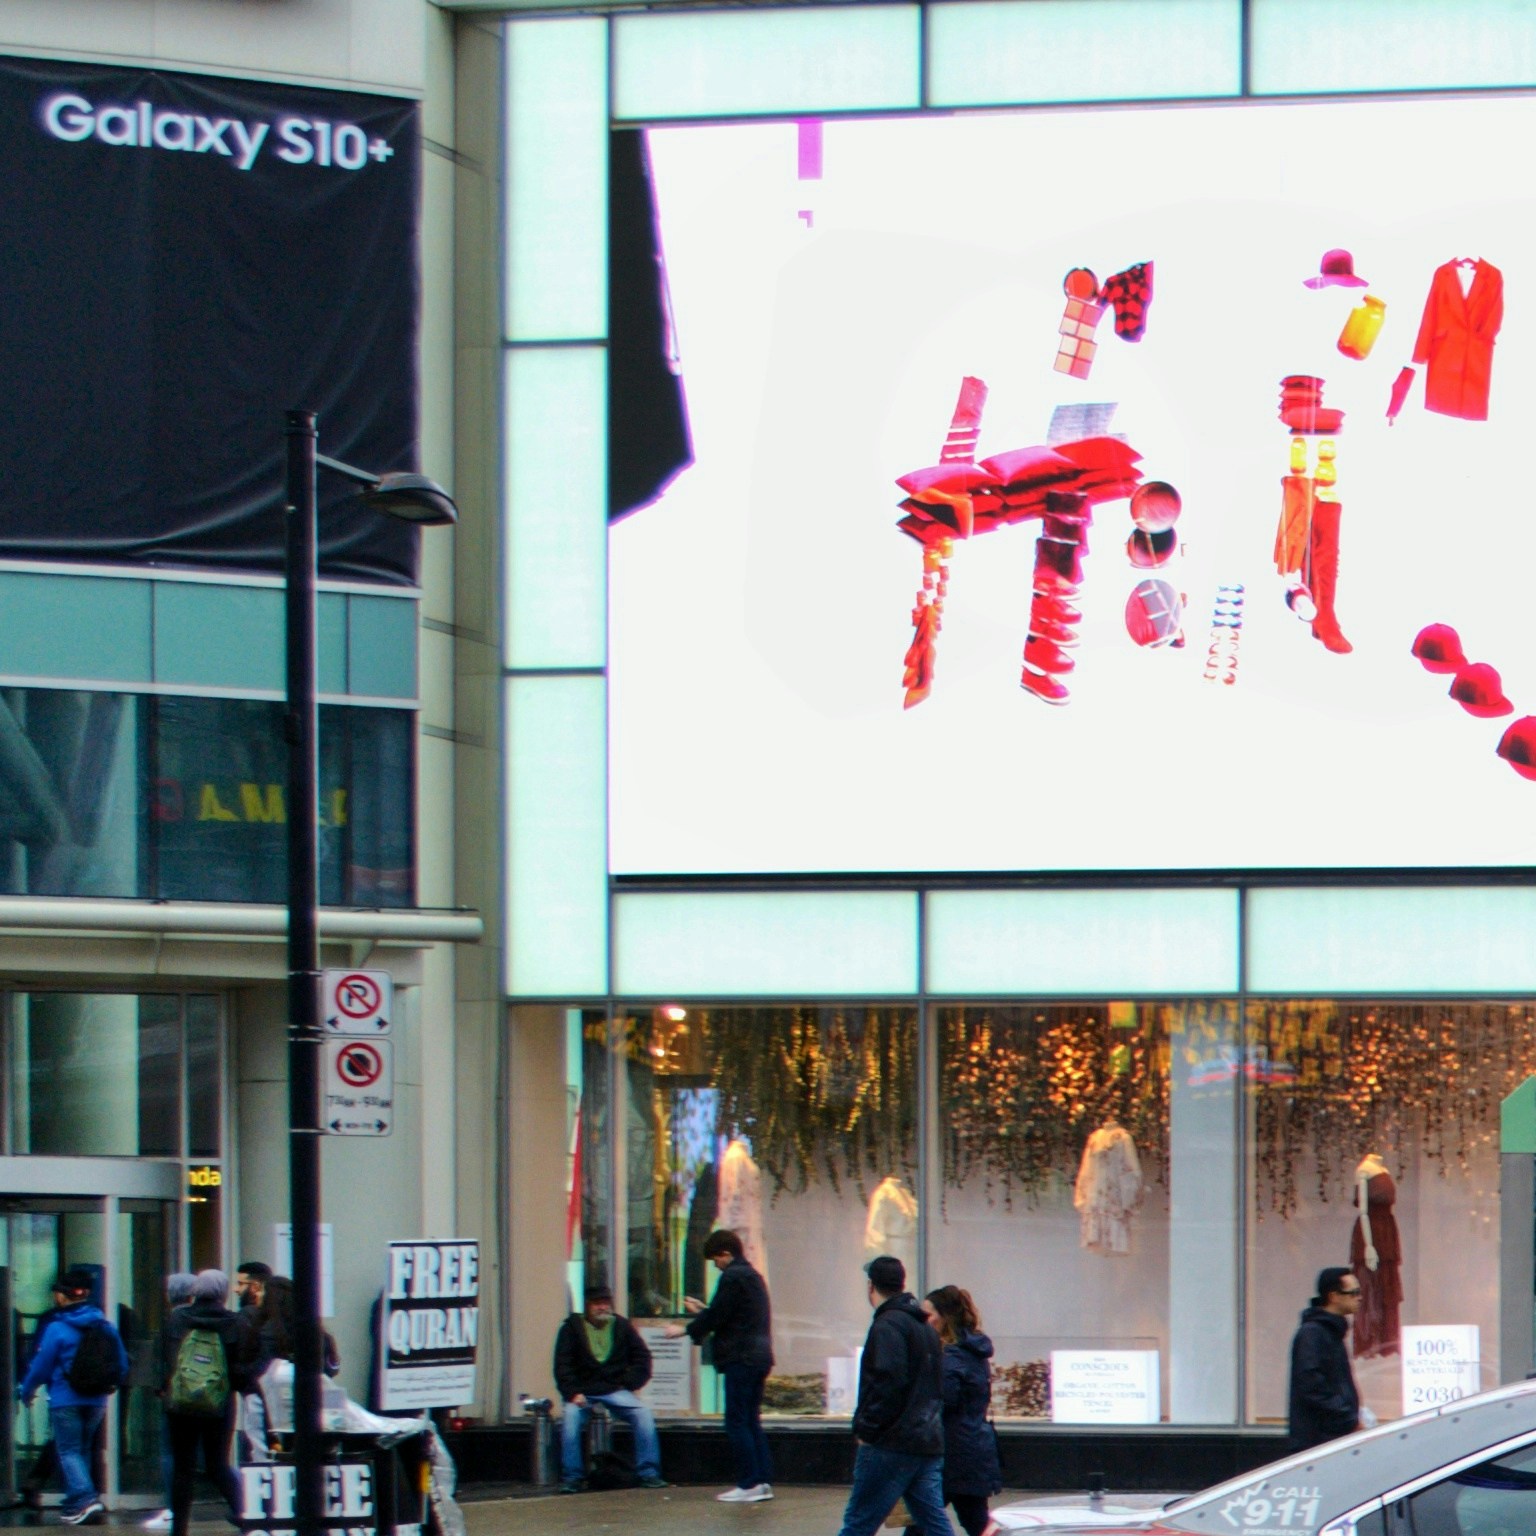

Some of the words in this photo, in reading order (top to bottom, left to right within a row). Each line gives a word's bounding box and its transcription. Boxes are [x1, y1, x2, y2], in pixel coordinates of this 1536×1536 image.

[48, 94, 270, 171] Galaxy
[278, 117, 394, 171] S10+
[389, 1245, 479, 1300] FREE
[388, 1307, 479, 1356] QURAN
[1416, 1339, 1458, 1356] 100%
[1413, 1386, 1464, 1404] 2030
[1271, 1486, 1323, 1498] CALL
[1242, 1528, 1314, 1536] EMERGENCY
